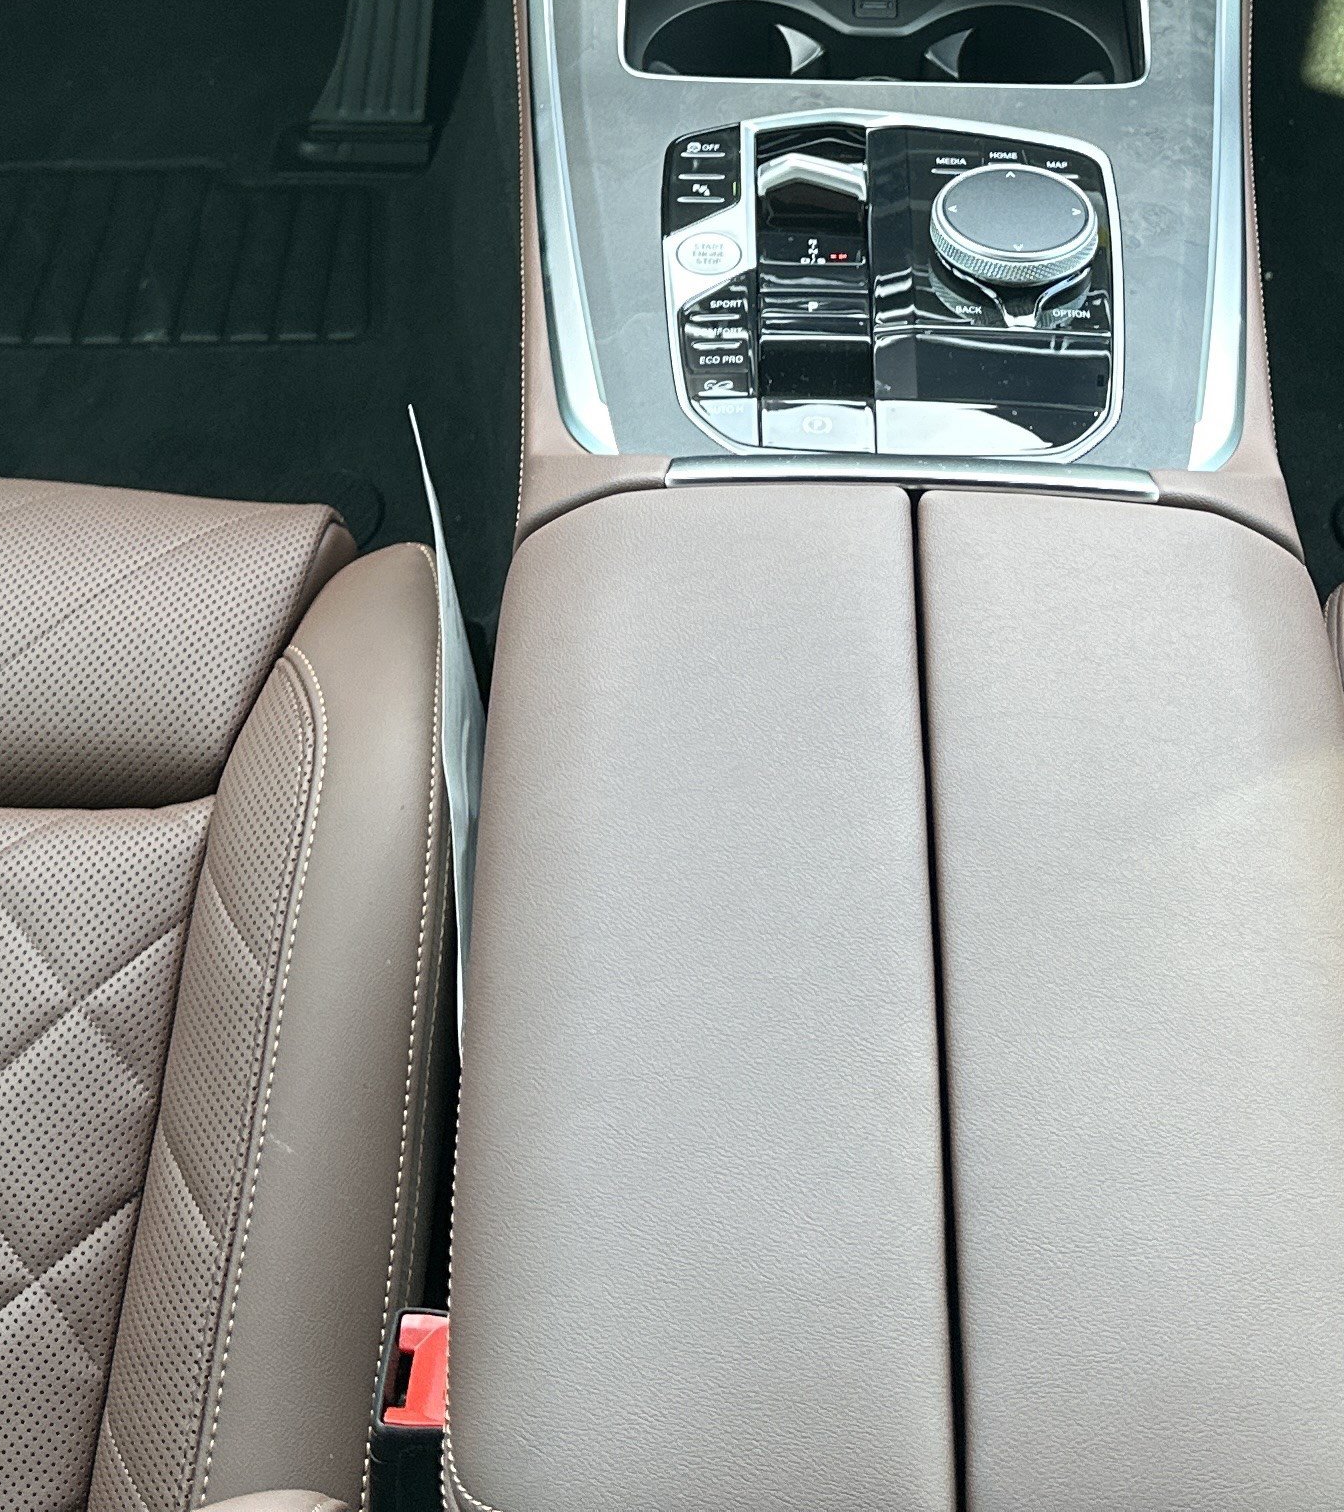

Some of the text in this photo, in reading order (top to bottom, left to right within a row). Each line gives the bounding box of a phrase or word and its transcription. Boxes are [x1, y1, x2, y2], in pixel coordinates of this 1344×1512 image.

[701, 143, 721, 152] OFF
[989, 151, 1018, 160] HOME
[935, 157, 967, 166] MEDIA
[1046, 160, 1068, 169] MAP
[710, 299, 743, 308] SPORT
[955, 306, 983, 315] BACK
[1052, 308, 1091, 319] OPTION
[699, 355, 744, 365] ECO PRO
